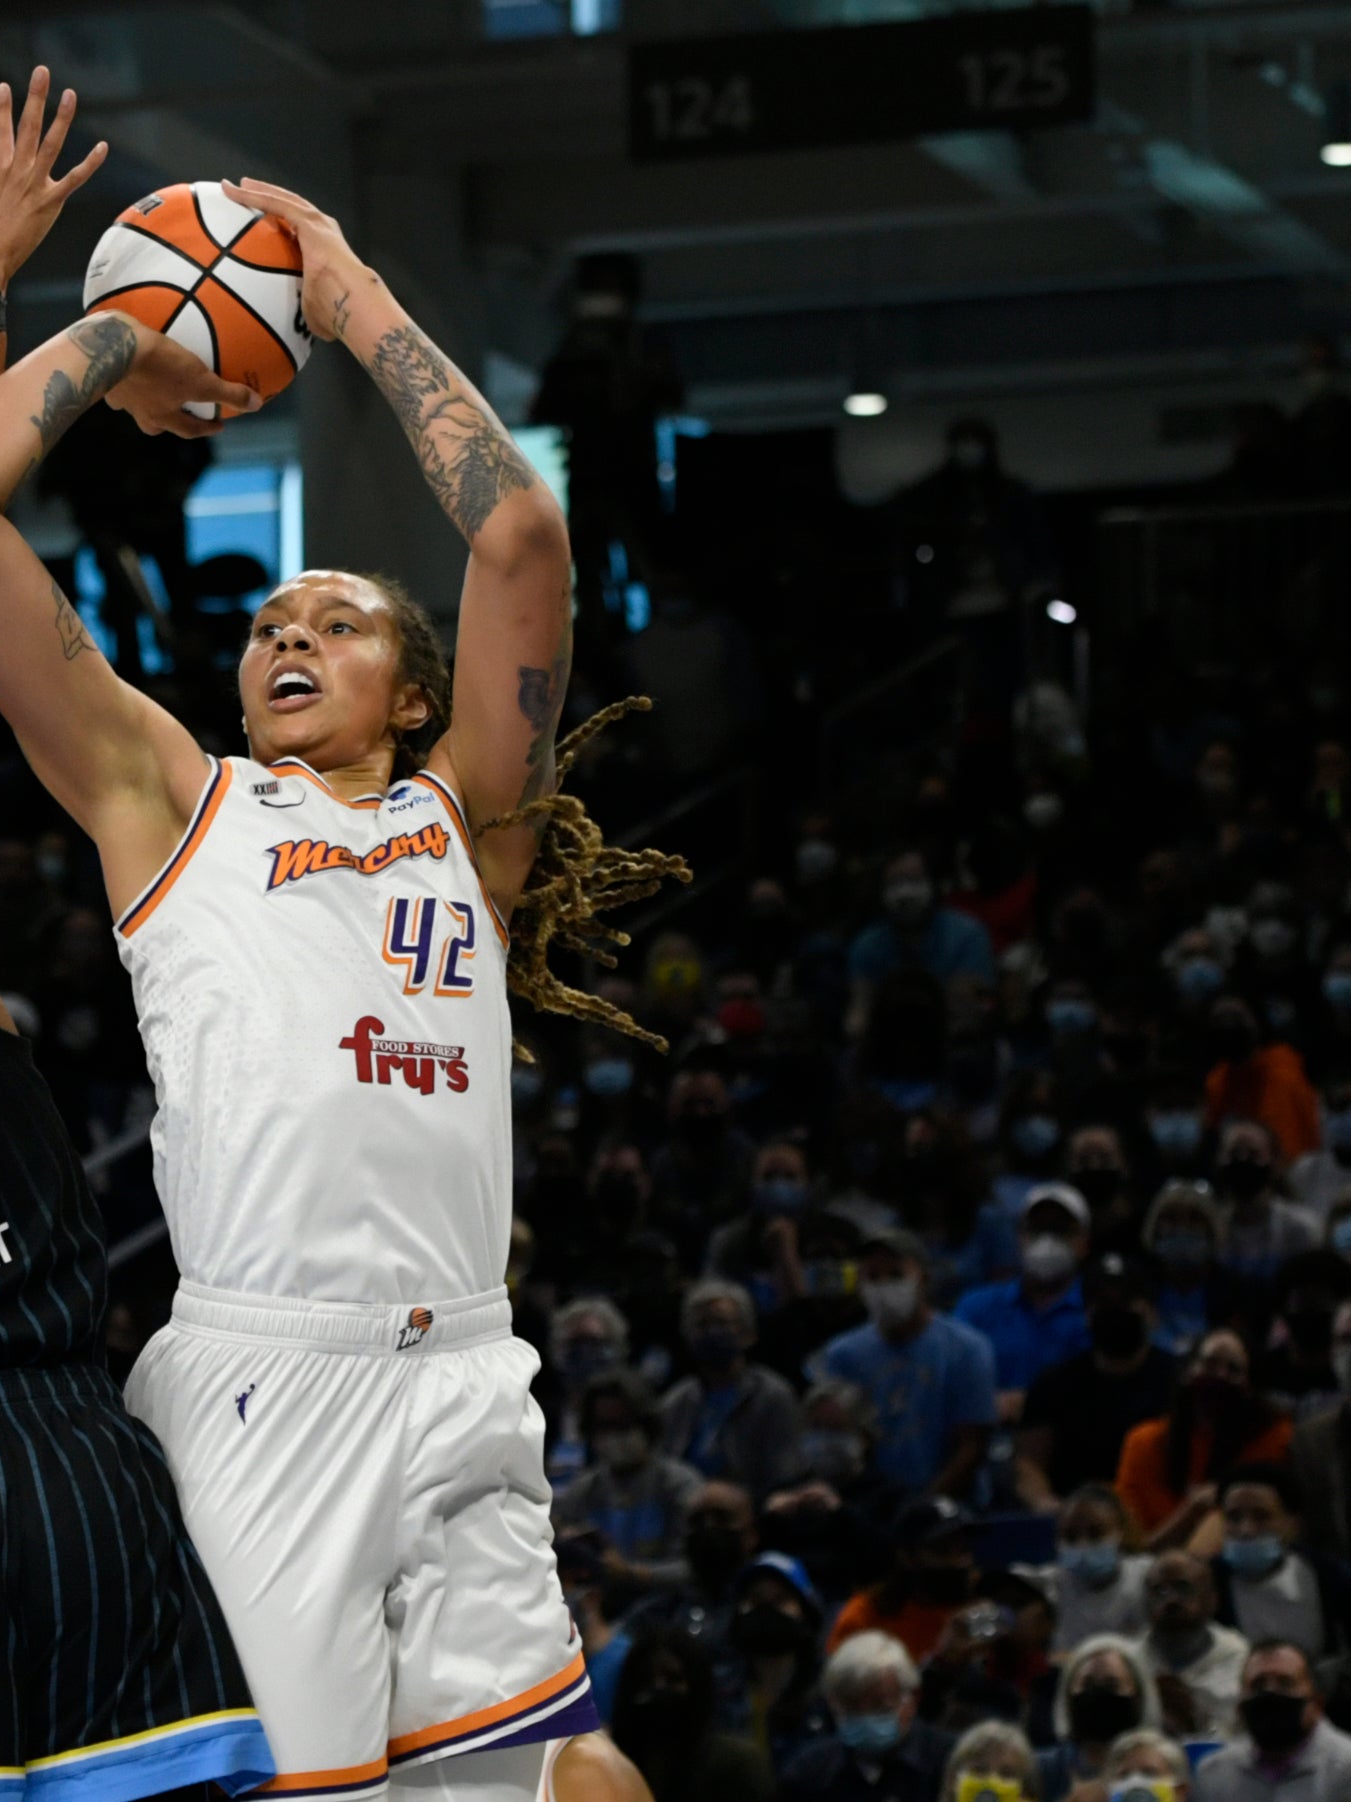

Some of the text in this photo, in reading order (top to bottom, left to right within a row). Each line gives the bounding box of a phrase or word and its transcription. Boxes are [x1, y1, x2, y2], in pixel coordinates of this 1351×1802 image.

[644, 42, 1073, 143] 124 125
[388, 791, 436, 814] PayPal
[264, 821, 451, 892] Mercury
[382, 895, 477, 998] 42
[339, 1015, 469, 1096] fry's
[371, 1038, 460, 1058] FOOD STORES
